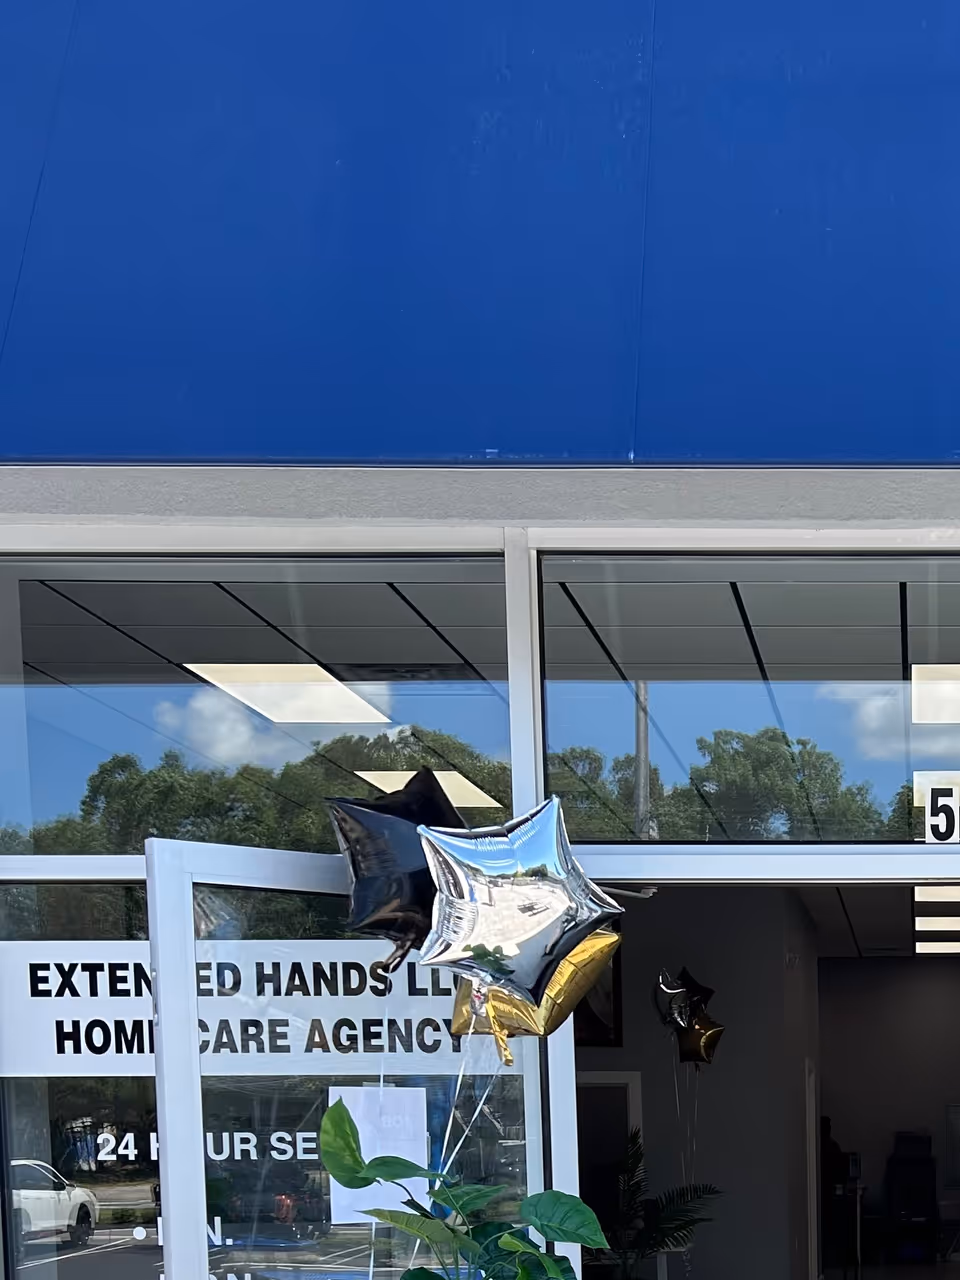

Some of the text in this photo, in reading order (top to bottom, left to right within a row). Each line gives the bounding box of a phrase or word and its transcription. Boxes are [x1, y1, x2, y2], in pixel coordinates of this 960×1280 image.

[930, 788, 955, 842] 5
[29, 961, 456, 997] EXTENED HANDS LL
[97, 1132, 138, 1161] 24
[270, 1131, 319, 1161] SE
